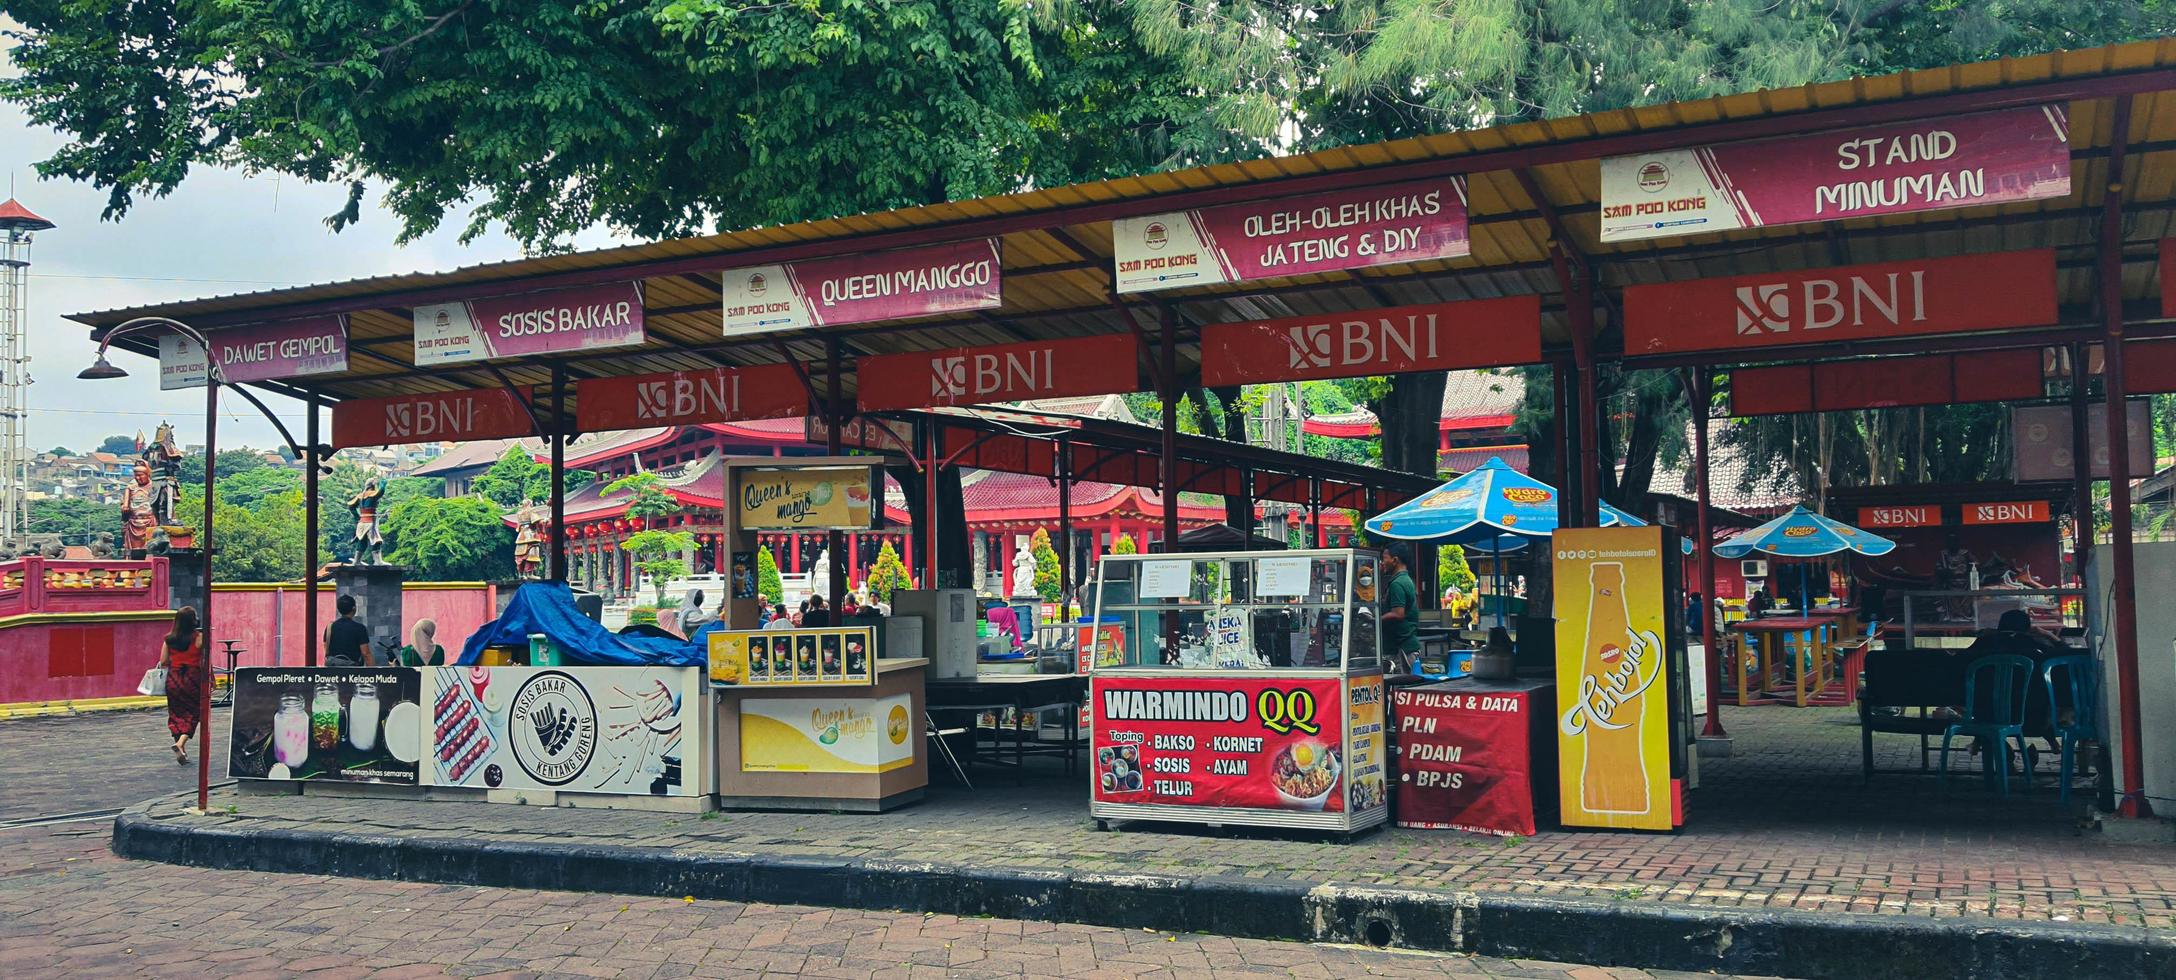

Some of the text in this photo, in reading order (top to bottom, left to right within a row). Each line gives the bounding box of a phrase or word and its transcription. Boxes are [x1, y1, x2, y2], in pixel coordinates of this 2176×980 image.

[1838, 129, 1958, 171] STAND
[1815, 167, 1986, 215] MINUMAN
[1244, 190, 1441, 238] OLEH-OLEH KHAS
[1603, 197, 1706, 219] SAM POO KONG
[1260, 226, 1422, 267] JATENG & DIY
[1119, 253, 1197, 273] SAM POO KONG
[821, 259, 991, 307] QUEEN MANGGO
[727, 301, 790, 317] SAM POO KONG
[1802, 270, 1928, 330] BNI
[499, 301, 632, 338] SOSIS BAKAR
[224, 335, 341, 365] DAWET GEMPOL
[1340, 313, 1439, 368] BNI
[973, 348, 1054, 396] BNI
[671, 375, 740, 417] BNI
[415, 397, 474, 434] BNI
[745, 476, 792, 511] Queen's
[1503, 487, 1546, 499] Hydro
[777, 495, 817, 523] mango
[1892, 508, 1926, 524] BNI
[1997, 504, 2033, 521] BNI
[256, 674, 282, 685] Gempol
[314, 674, 339, 684] Dawet
[349, 674, 375, 685] Kelapa
[375, 675, 397, 684] Muda
[516, 680, 566, 721] SOSIS BAKAR
[1415, 693, 1461, 709] PULSA
[1466, 696, 1477, 710] &
[1481, 696, 1518, 713] DATA
[1104, 689, 1320, 735] WARMINDO QQ
[1402, 716, 1437, 734] PLN
[536, 716, 592, 778] KENTANG GORENG
[1110, 730, 1144, 743] Toping
[1154, 735, 1195, 751] BAKSO
[1213, 736, 1263, 753] KORNET
[1409, 743, 1462, 762] PDAM
[383, 770, 414, 780] semarang
[1153, 758, 1190, 773] SOSIS
[1213, 760, 1248, 776] AYAM
[1154, 780, 1193, 796] TELUR
[1417, 770, 1463, 789] BPJS
